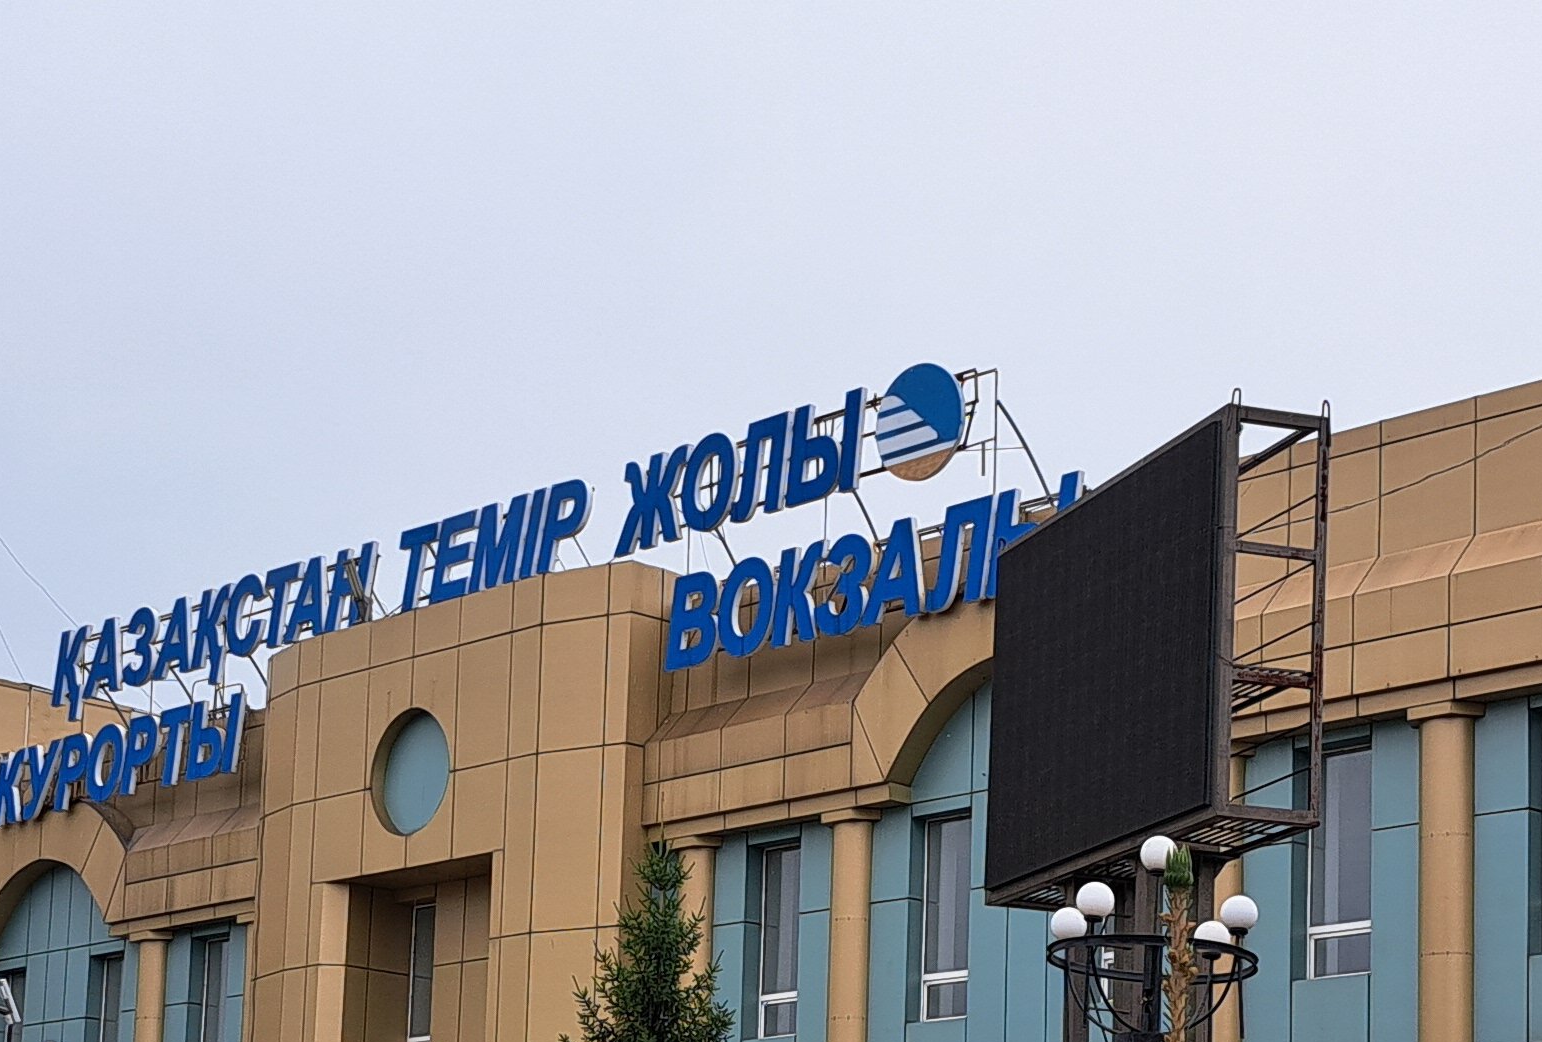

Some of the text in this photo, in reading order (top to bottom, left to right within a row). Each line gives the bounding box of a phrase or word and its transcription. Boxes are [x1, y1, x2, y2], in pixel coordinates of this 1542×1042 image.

[51, 387, 868, 721] ҚАЗАҚСТАН ТЕМІР ЖОЛЫ
